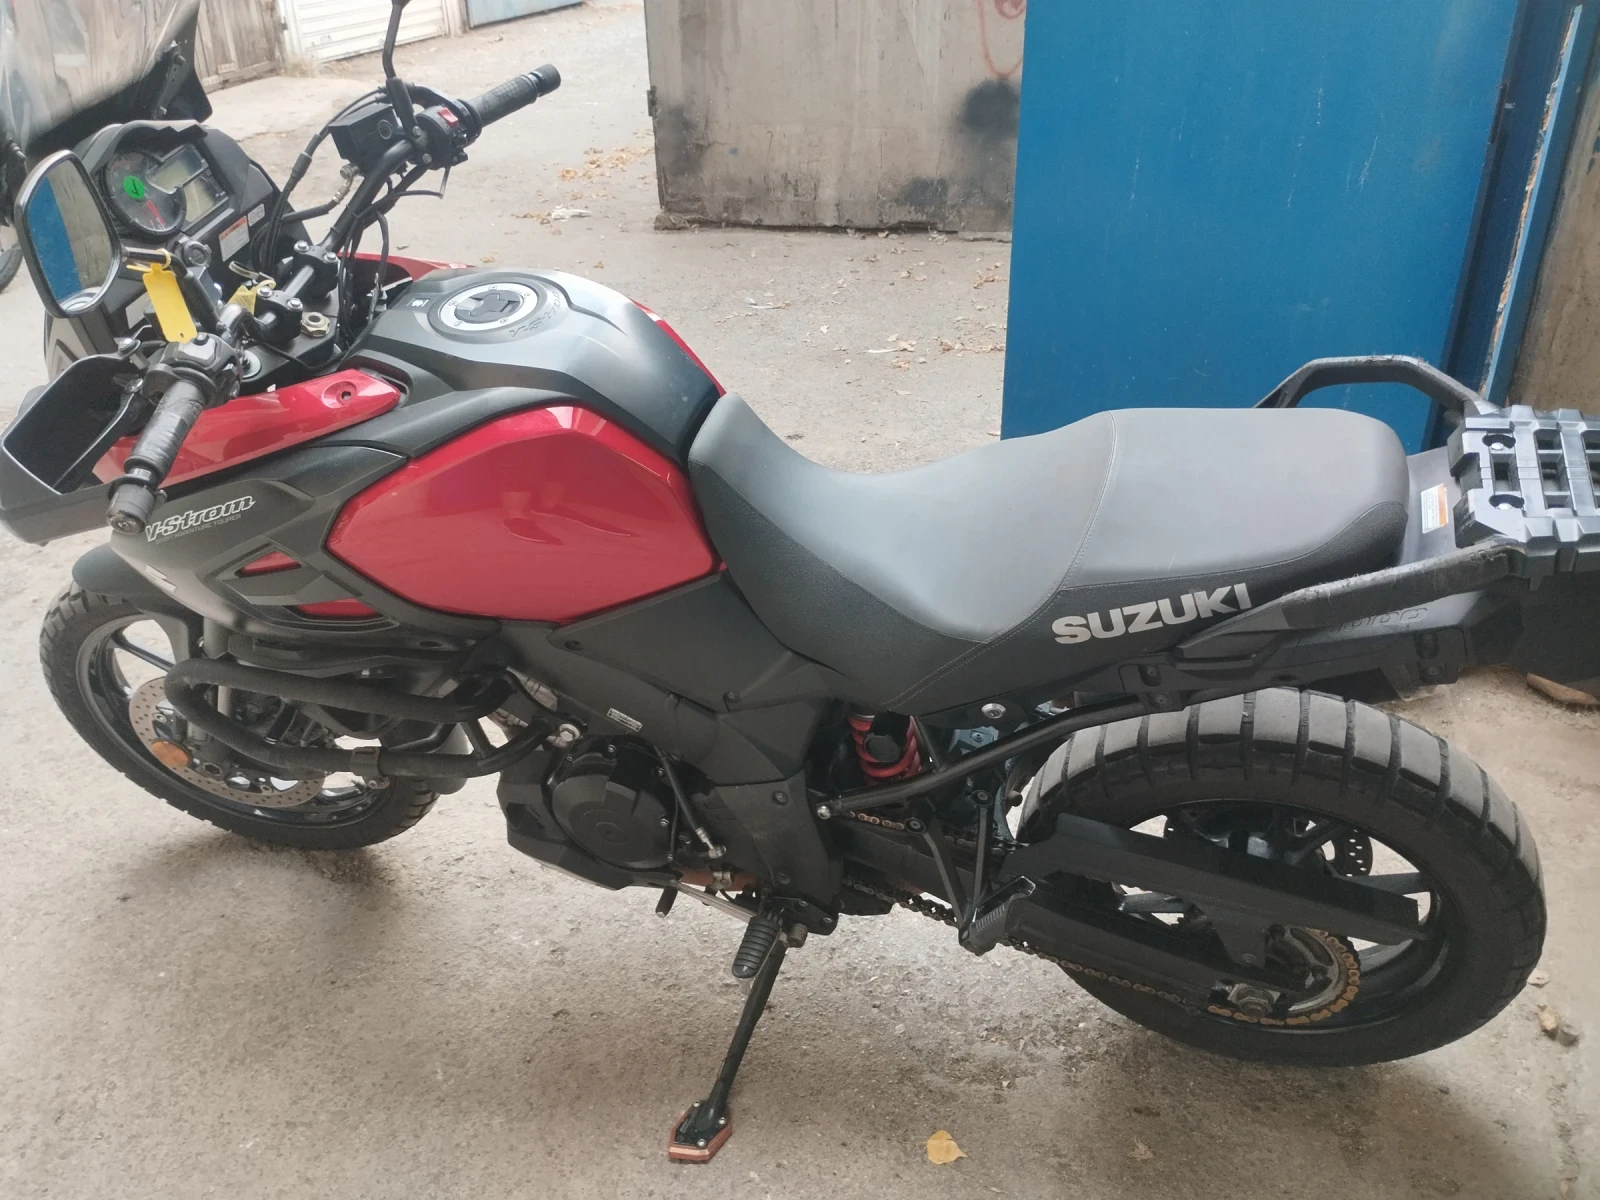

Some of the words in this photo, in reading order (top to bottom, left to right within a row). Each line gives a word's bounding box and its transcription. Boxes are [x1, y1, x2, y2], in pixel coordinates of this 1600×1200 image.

[145, 496, 256, 542] V-Strom
[213, 514, 242, 525] TOURER
[1052, 583, 1252, 645] SUZUKI
